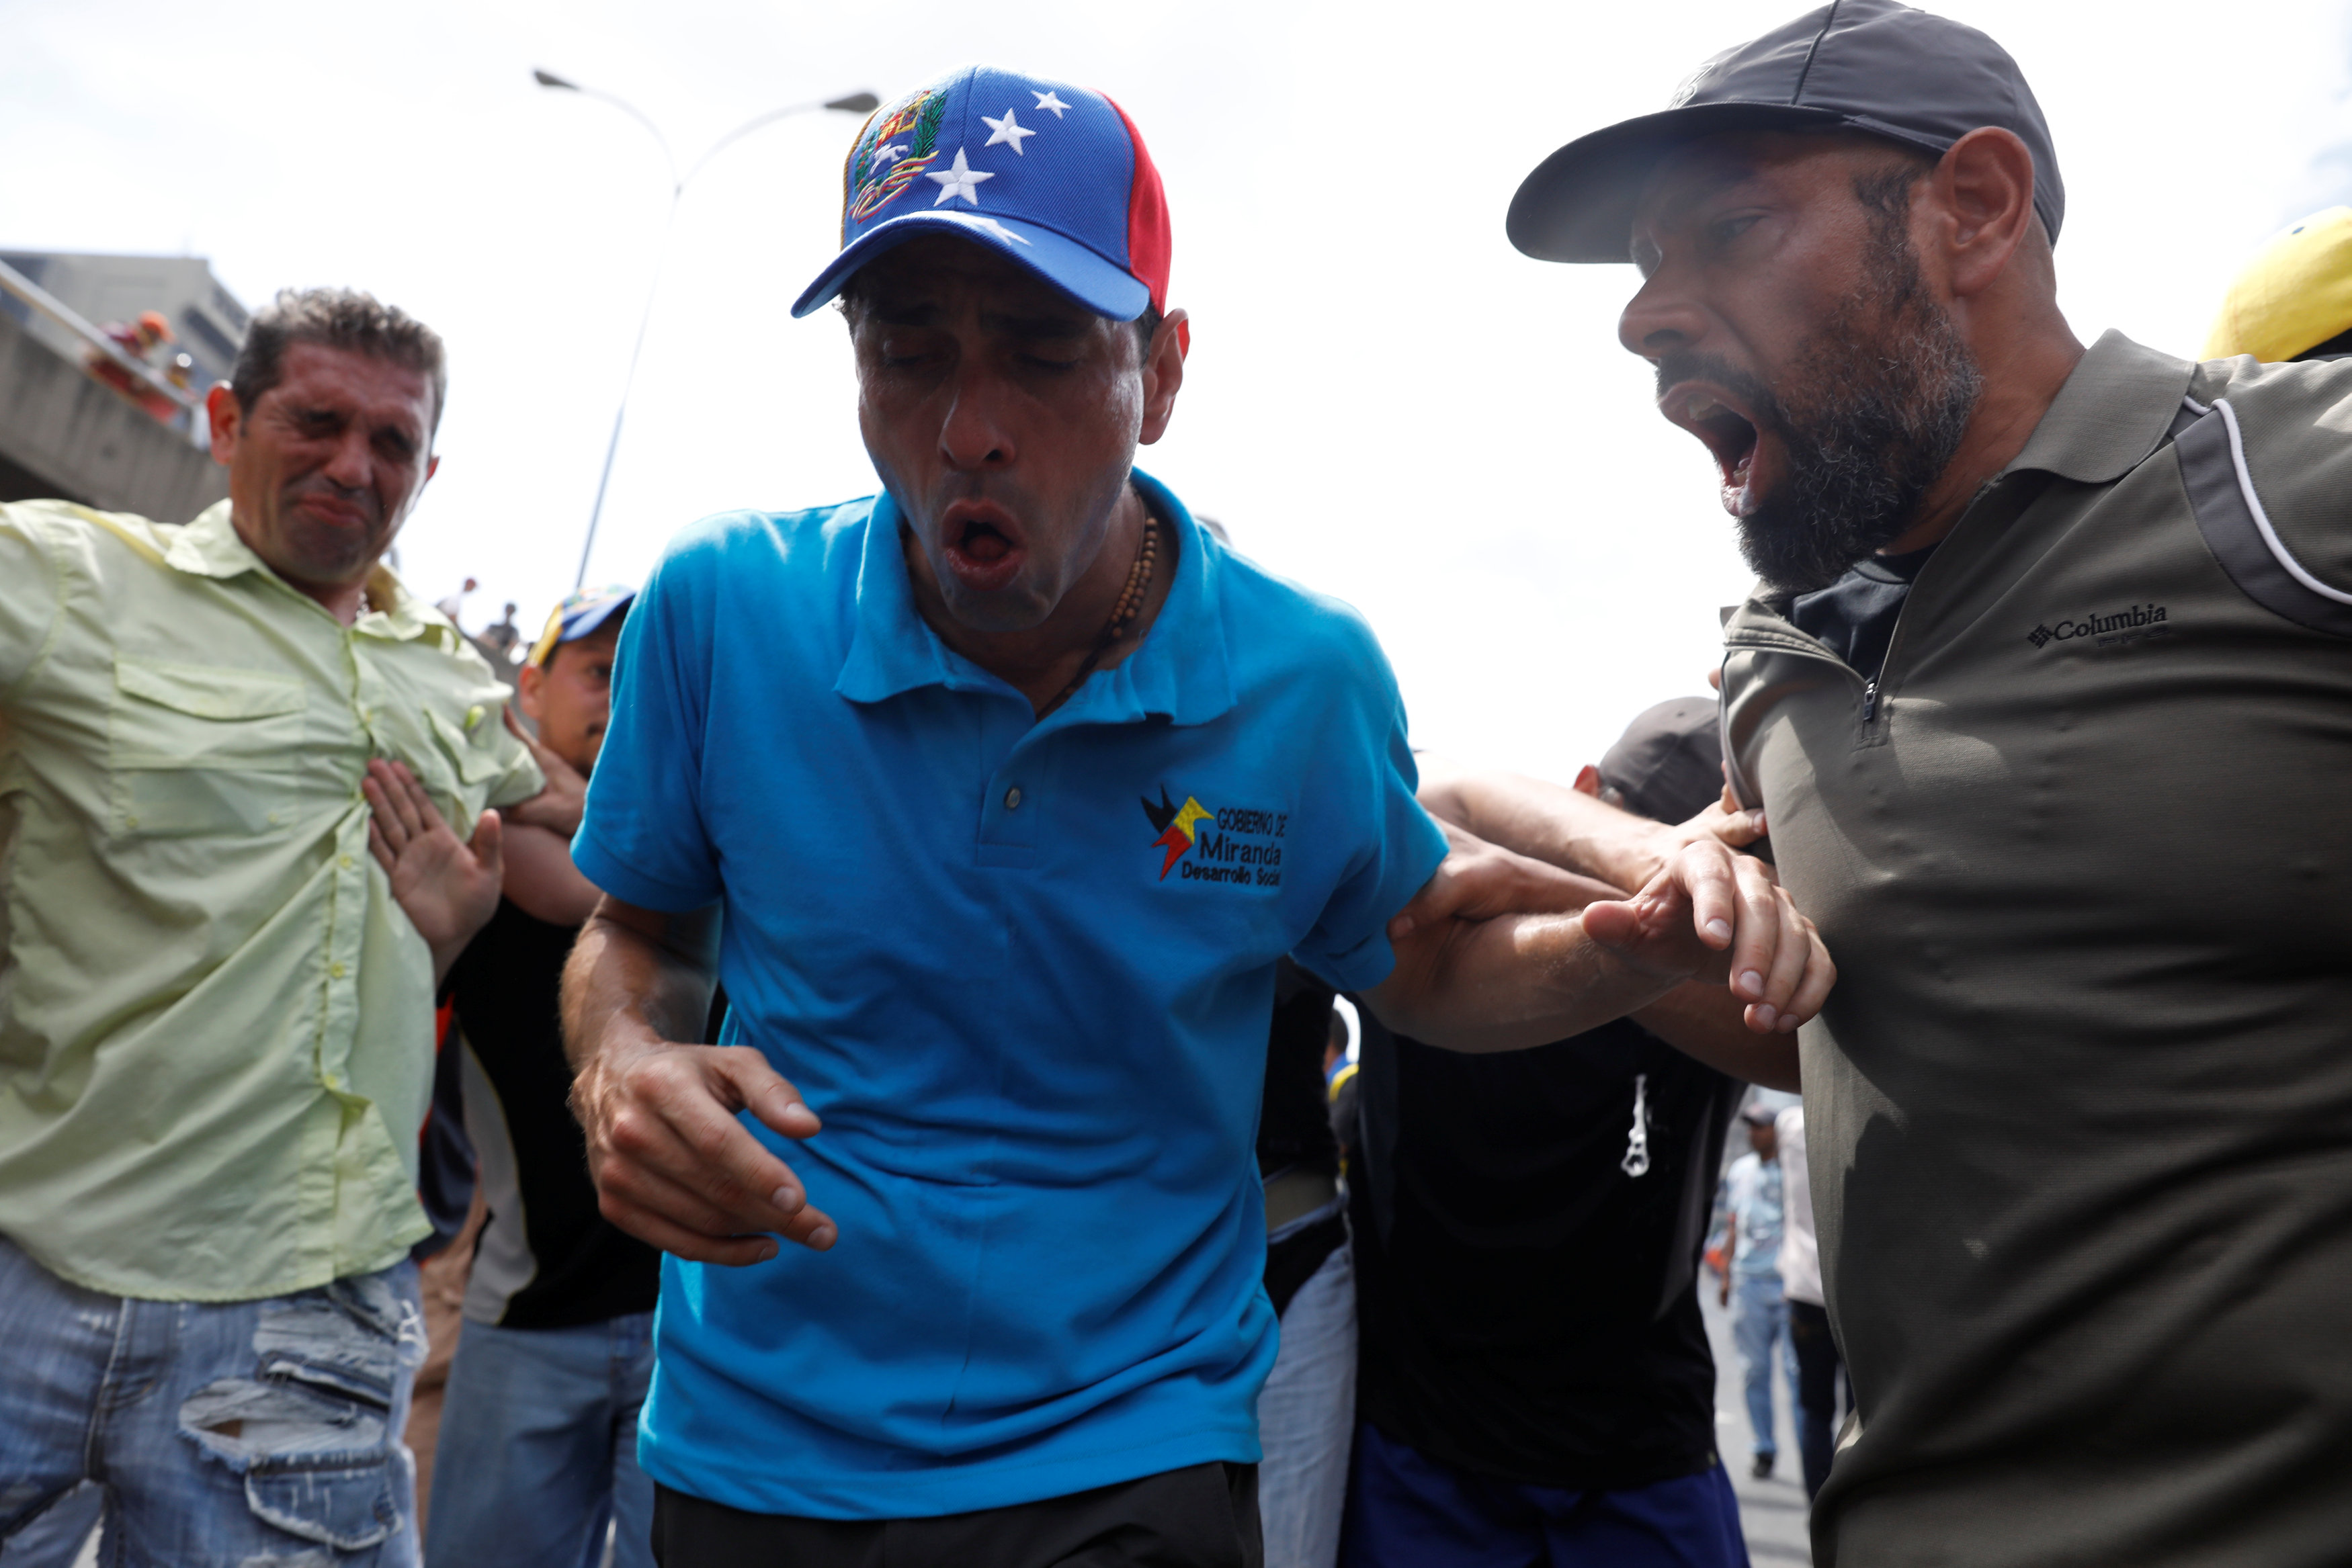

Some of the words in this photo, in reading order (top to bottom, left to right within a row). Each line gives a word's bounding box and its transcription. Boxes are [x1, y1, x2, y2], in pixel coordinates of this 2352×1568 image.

[2054, 604, 2167, 641] Columbia
[1217, 808, 1273, 836] GOBIERNO
[1200, 831, 1281, 865] Miranda
[1181, 861, 1251, 885] Desarrollo
